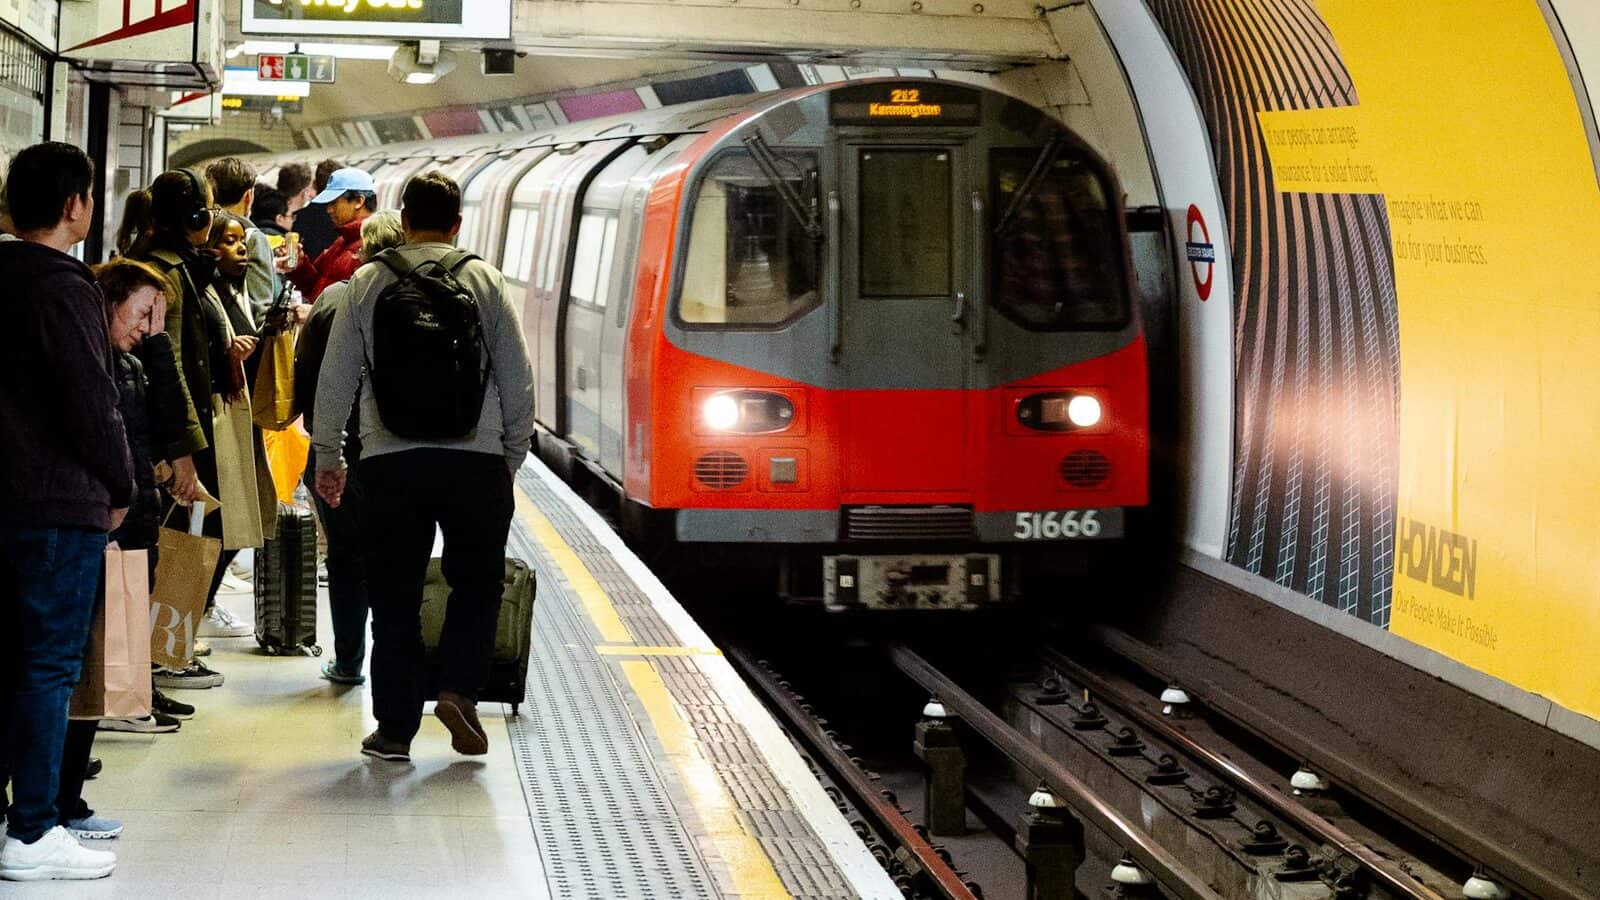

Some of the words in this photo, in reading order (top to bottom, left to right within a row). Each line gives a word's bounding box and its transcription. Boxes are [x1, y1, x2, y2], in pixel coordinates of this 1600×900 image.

[870, 103, 941, 118] Kennington
[1287, 125, 1312, 150] people
[1312, 128, 1327, 145] can
[1327, 126, 1358, 149] arrange
[1310, 158, 1321, 182] for
[1424, 193, 1448, 220] what
[1448, 201, 1463, 220] we
[1464, 201, 1483, 221] can
[1396, 235, 1408, 260] do
[1408, 233, 1421, 260] for
[1423, 242, 1442, 268] your
[1442, 235, 1488, 265] business.
[1014, 510, 1101, 539] 51666
[1398, 517, 1477, 601] HOWDEN
[1395, 590, 1409, 614] Our
[1409, 595, 1434, 624] People
[1435, 606, 1456, 634] Make
[1456, 614, 1465, 637] It
[1465, 617, 1498, 650] Possible
